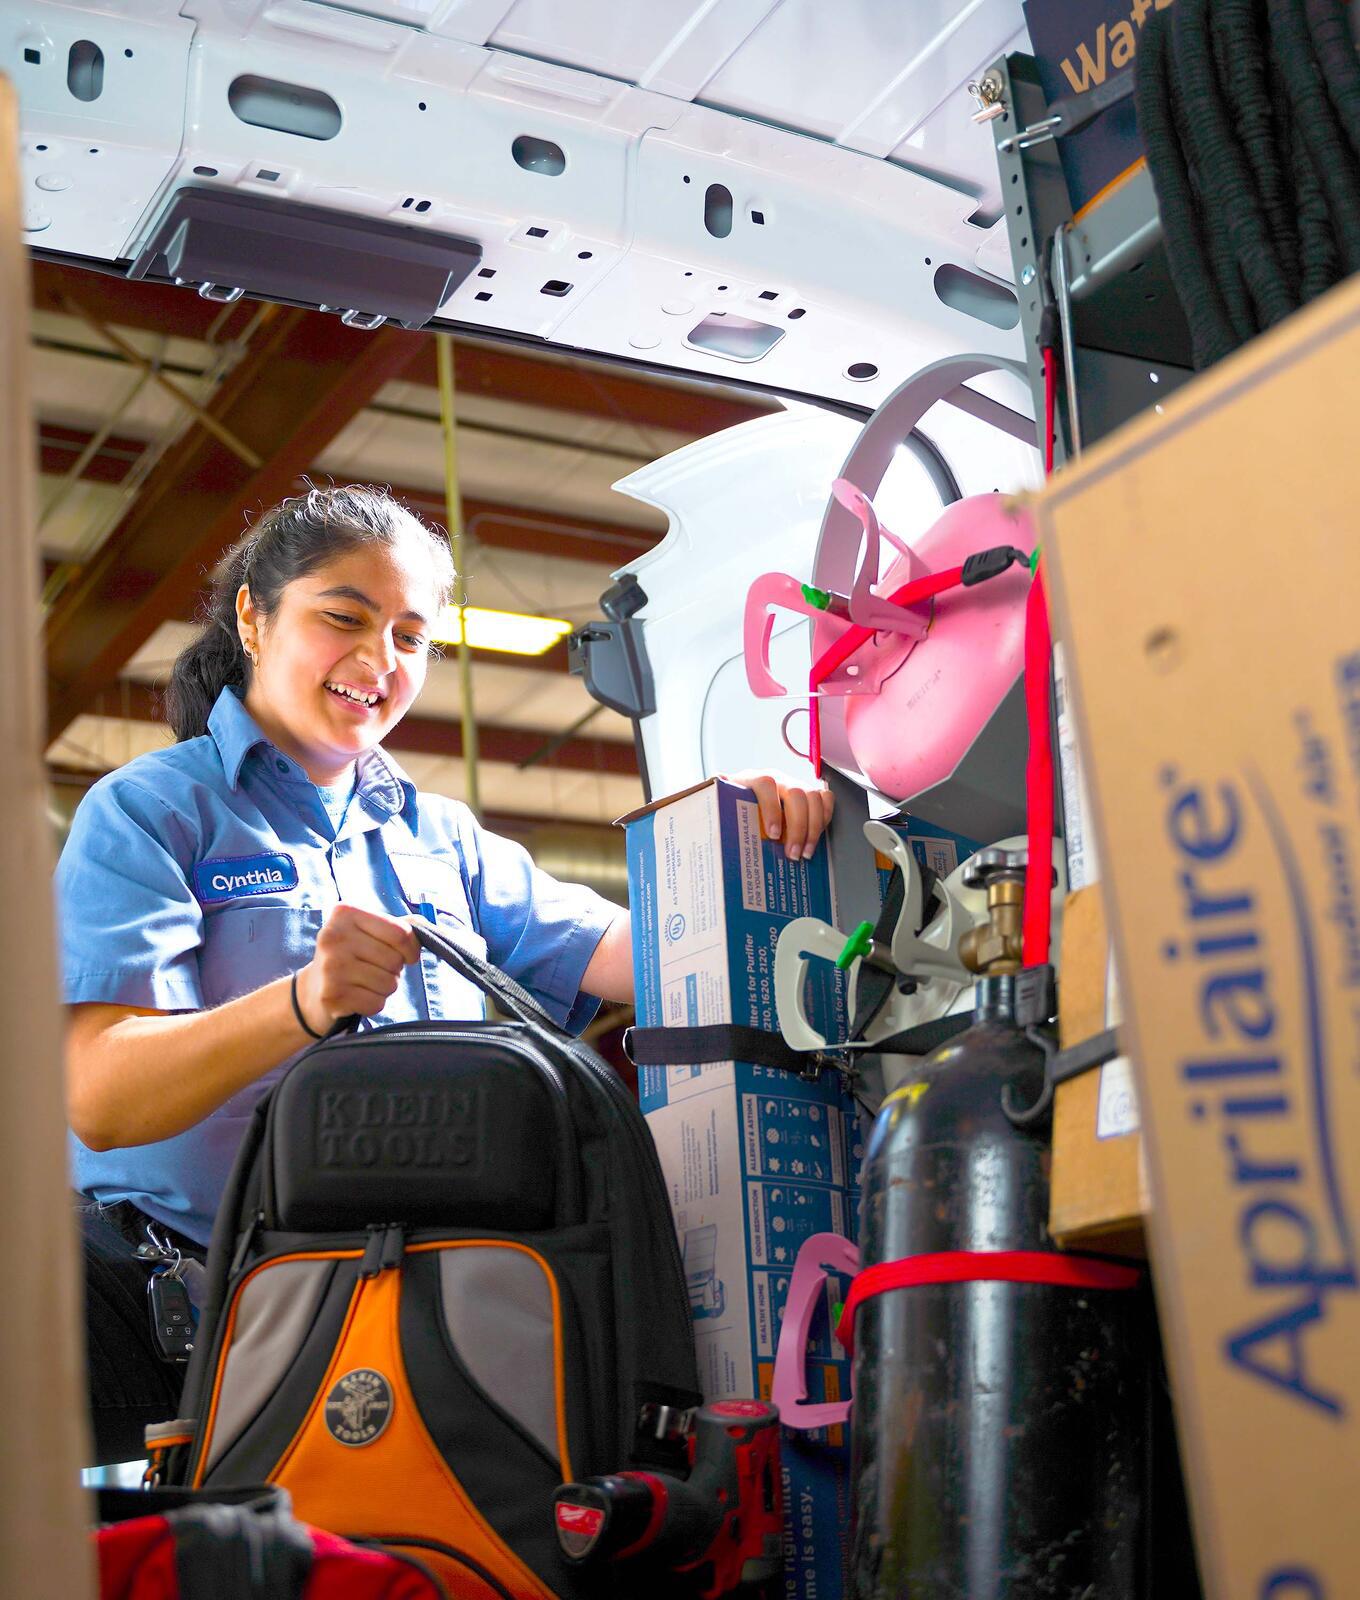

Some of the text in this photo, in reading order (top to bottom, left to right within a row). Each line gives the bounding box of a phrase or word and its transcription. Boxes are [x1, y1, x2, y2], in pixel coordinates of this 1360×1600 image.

[741, 805, 754, 906] FILTER OPTIONS AVAILABLE
[751, 834, 759, 868] PURIFIER
[212, 867, 284, 892] Cynthia
[777, 858, 785, 879] HOME
[800, 860, 808, 896] REDUCTIO
[645, 882, 653, 931] aprilaire.com
[745, 933, 755, 973] Purifier
[758, 945, 768, 974] 2120,
[747, 975, 756, 991] for
[761, 976, 771, 1005] 1620,
[833, 966, 843, 995] Purifi
[748, 993, 757, 1002] is
[835, 997, 843, 1012] for
[836, 1014, 844, 1023] is
[319, 1091, 474, 1127] KLEIN
[746, 1098, 754, 1129] ASTHMA
[1160, 780, 1357, 1421] Aprilaire
[319, 1130, 473, 1165] TOOLS
[749, 1138, 757, 1171] ALLERGY
[752, 1189, 762, 1258] ODOR REDUCTION
[757, 1283, 767, 1344] HEALTHY HOME
[799, 1485, 814, 1539] easy.
[801, 1544, 815, 1562] is
